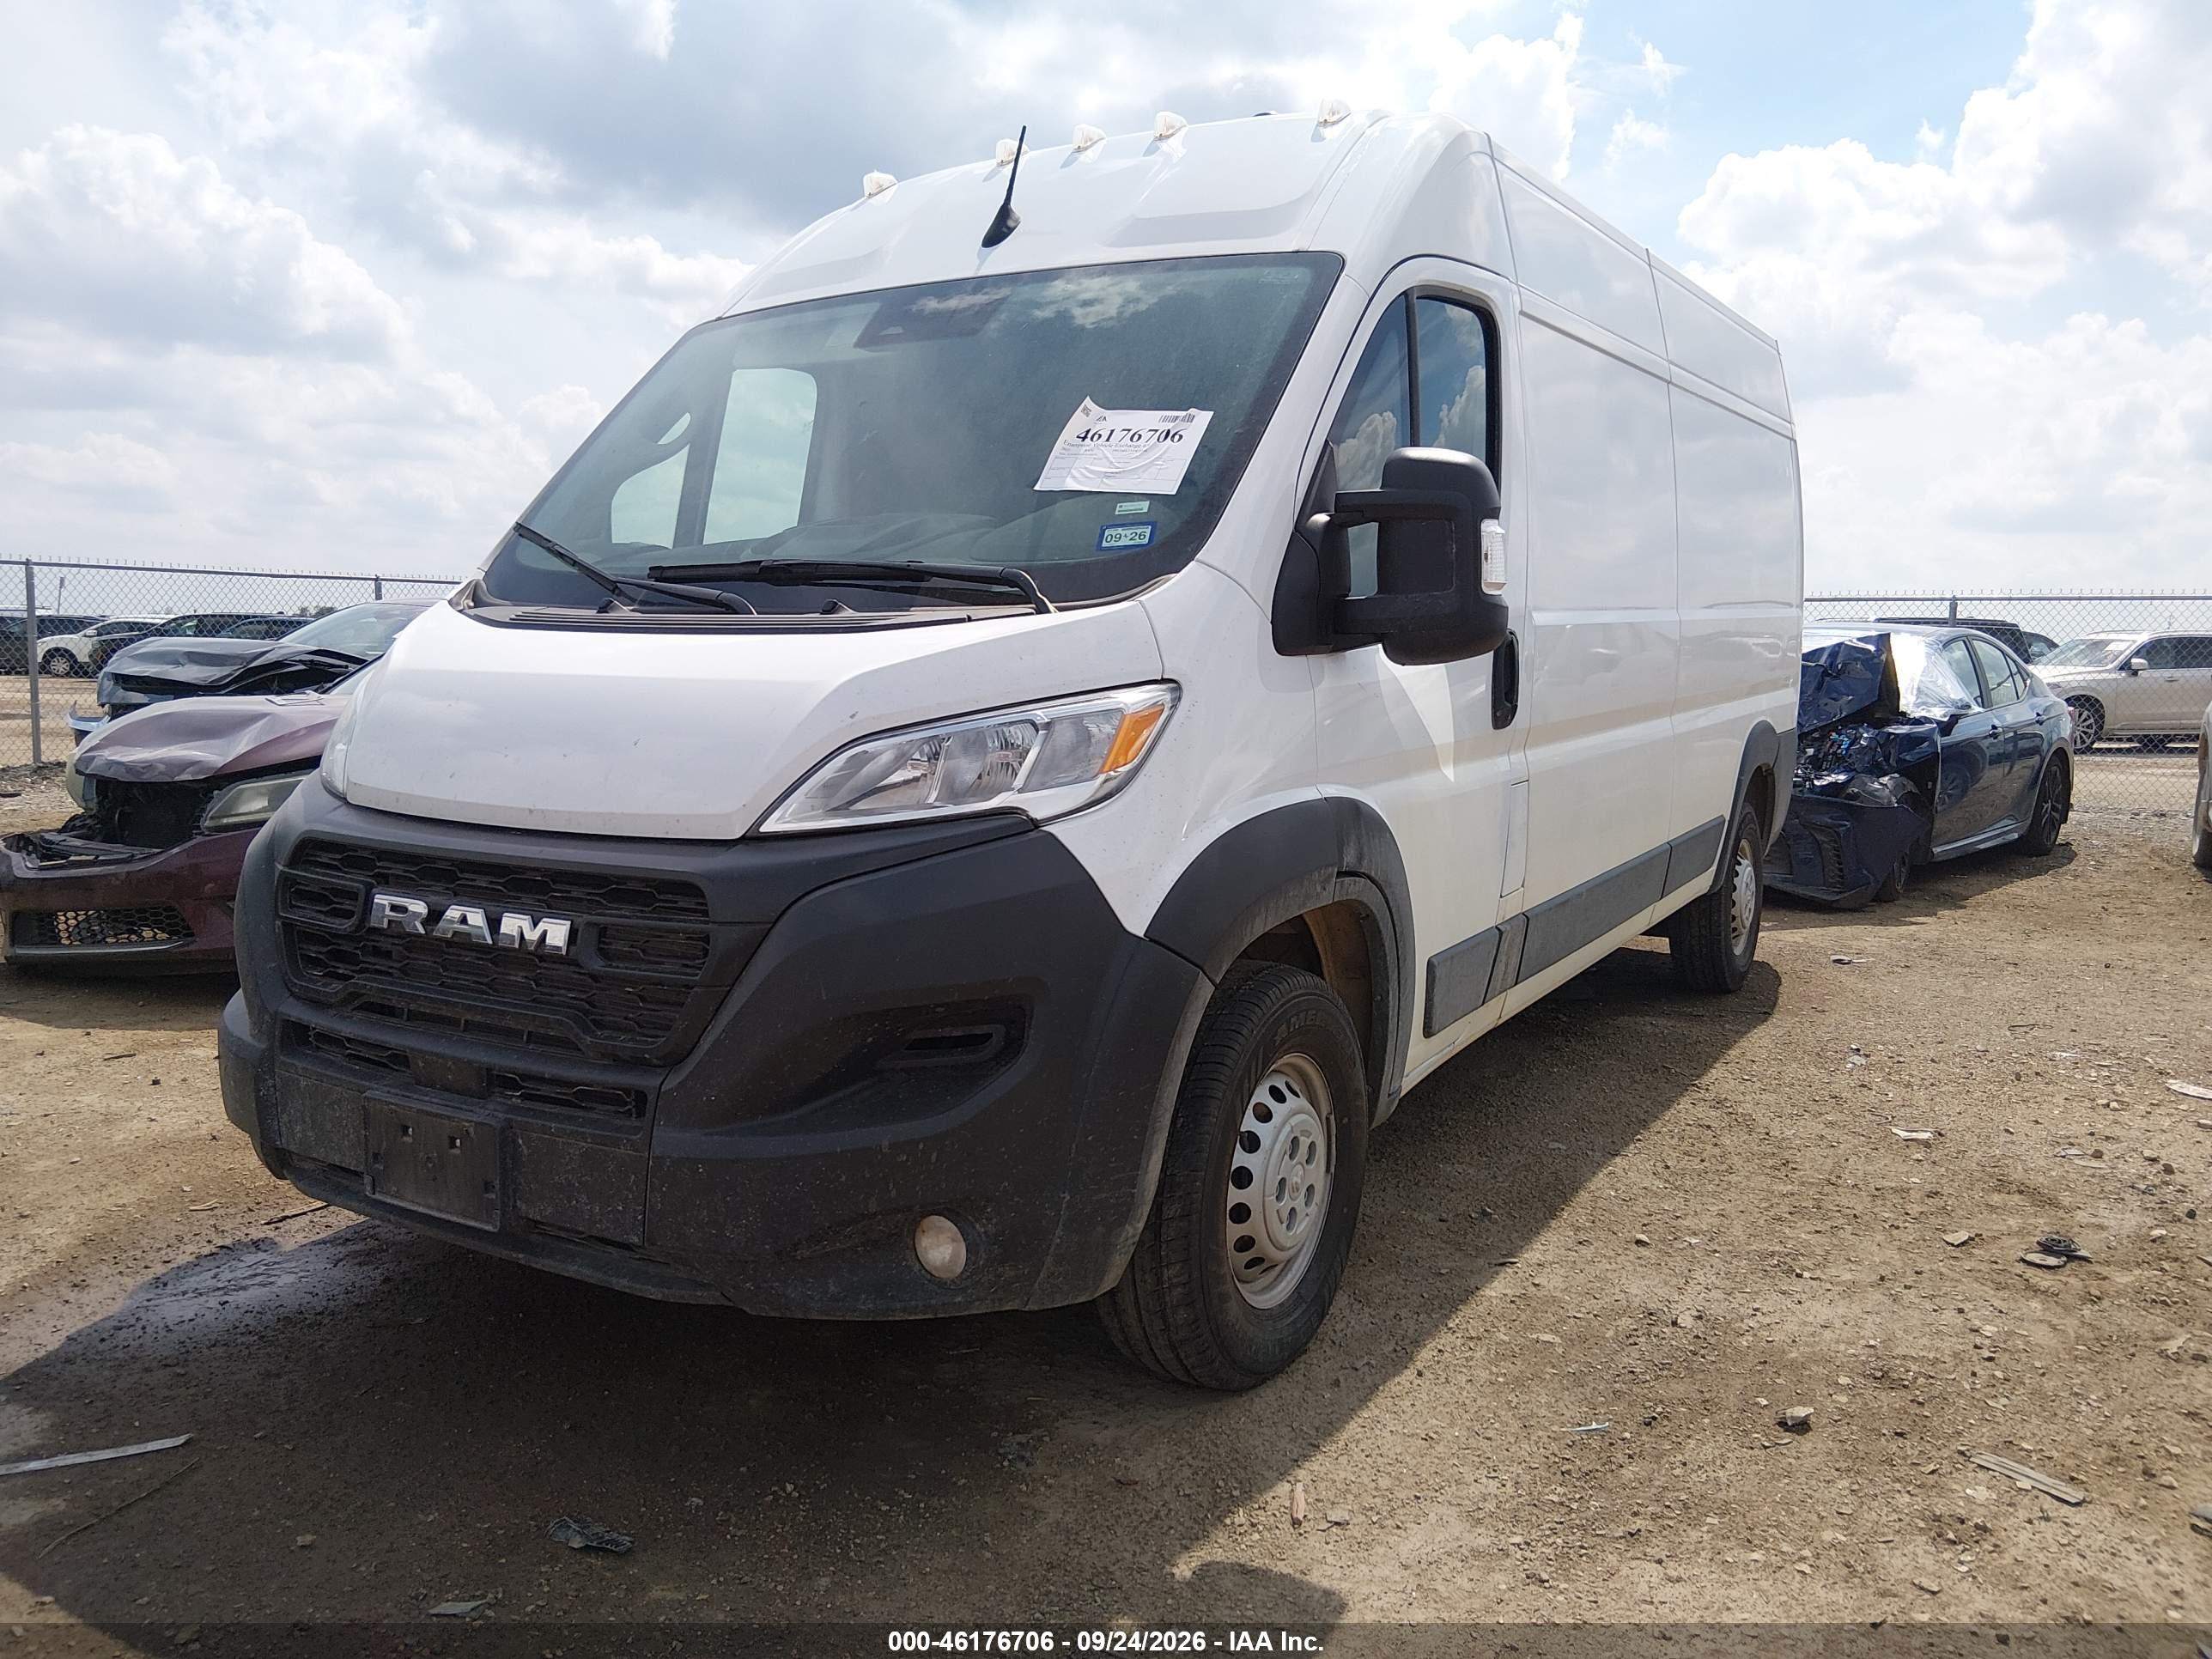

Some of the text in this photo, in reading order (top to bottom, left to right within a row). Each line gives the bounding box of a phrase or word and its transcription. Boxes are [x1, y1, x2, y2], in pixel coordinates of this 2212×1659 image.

[1076, 428, 1188, 444] 46176706
[1104, 533, 1122, 544] 09
[1128, 531, 1147, 541] 26
[369, 893, 572, 956] RAM
